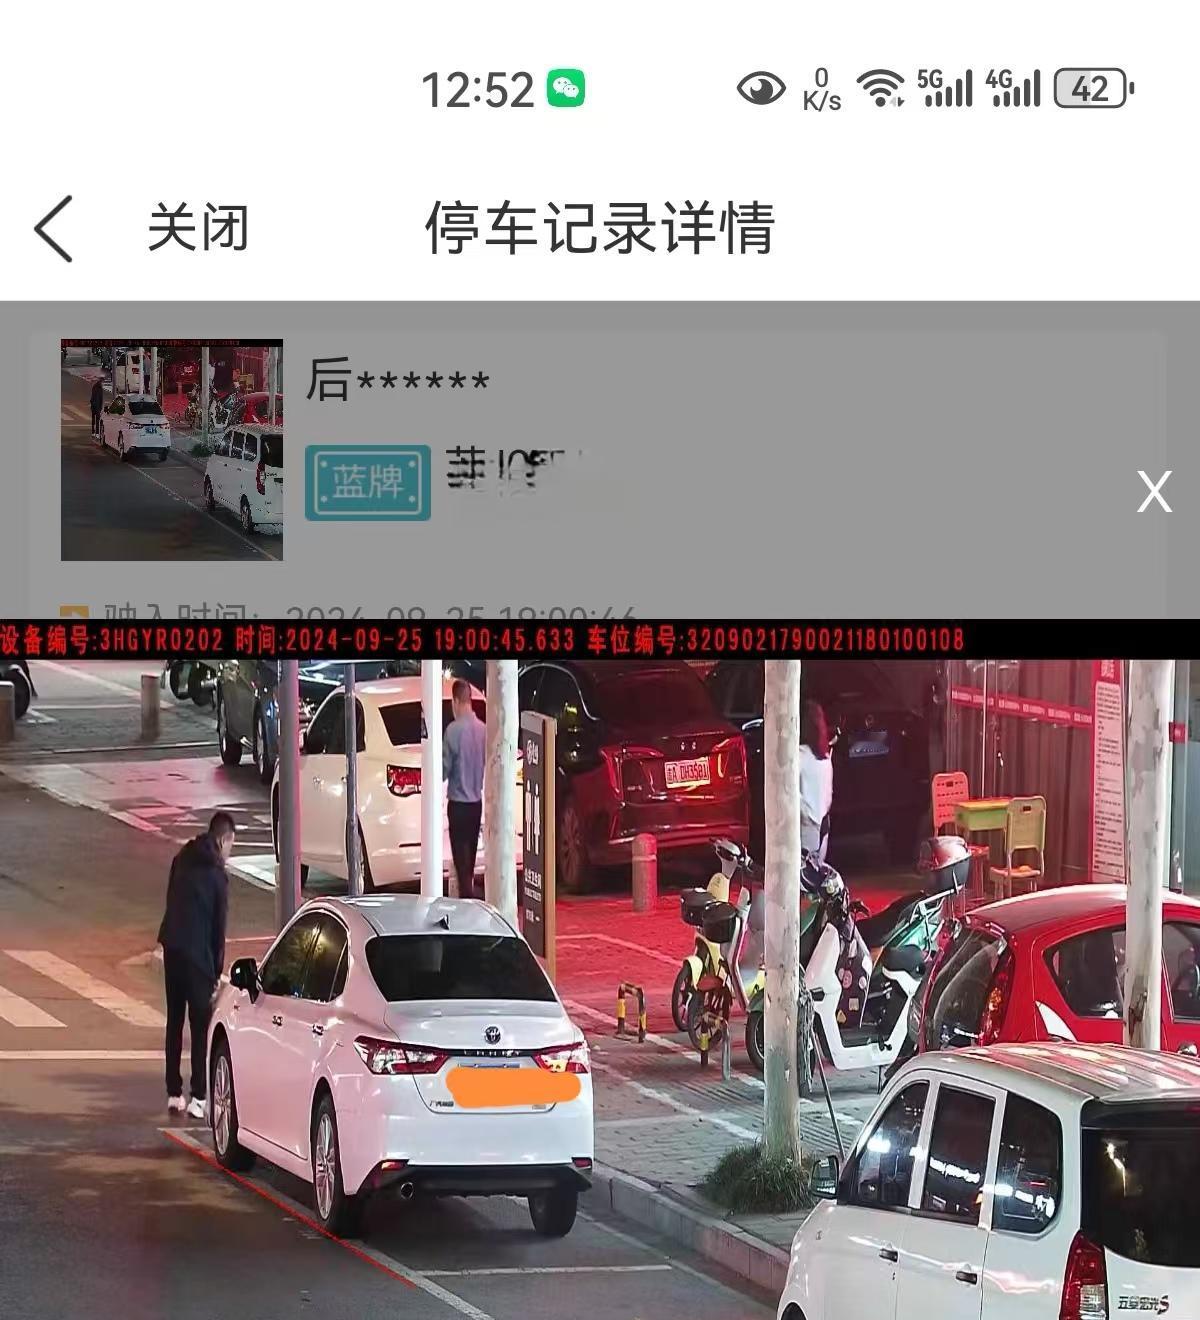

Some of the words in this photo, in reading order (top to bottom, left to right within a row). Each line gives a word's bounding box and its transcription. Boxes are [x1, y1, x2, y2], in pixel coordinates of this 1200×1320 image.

[422, 71, 535, 108] 12:52
[815, 67, 829, 88] 0
[917, 68, 943, 89] 5G
[985, 68, 1013, 89] 4G
[1071, 75, 1109, 102] 42
[803, 91, 842, 113] K/s
[148, 201, 248, 252] 关闭
[424, 199, 776, 256] 停车记录详情
[332, 463, 404, 499] 蓝牌
